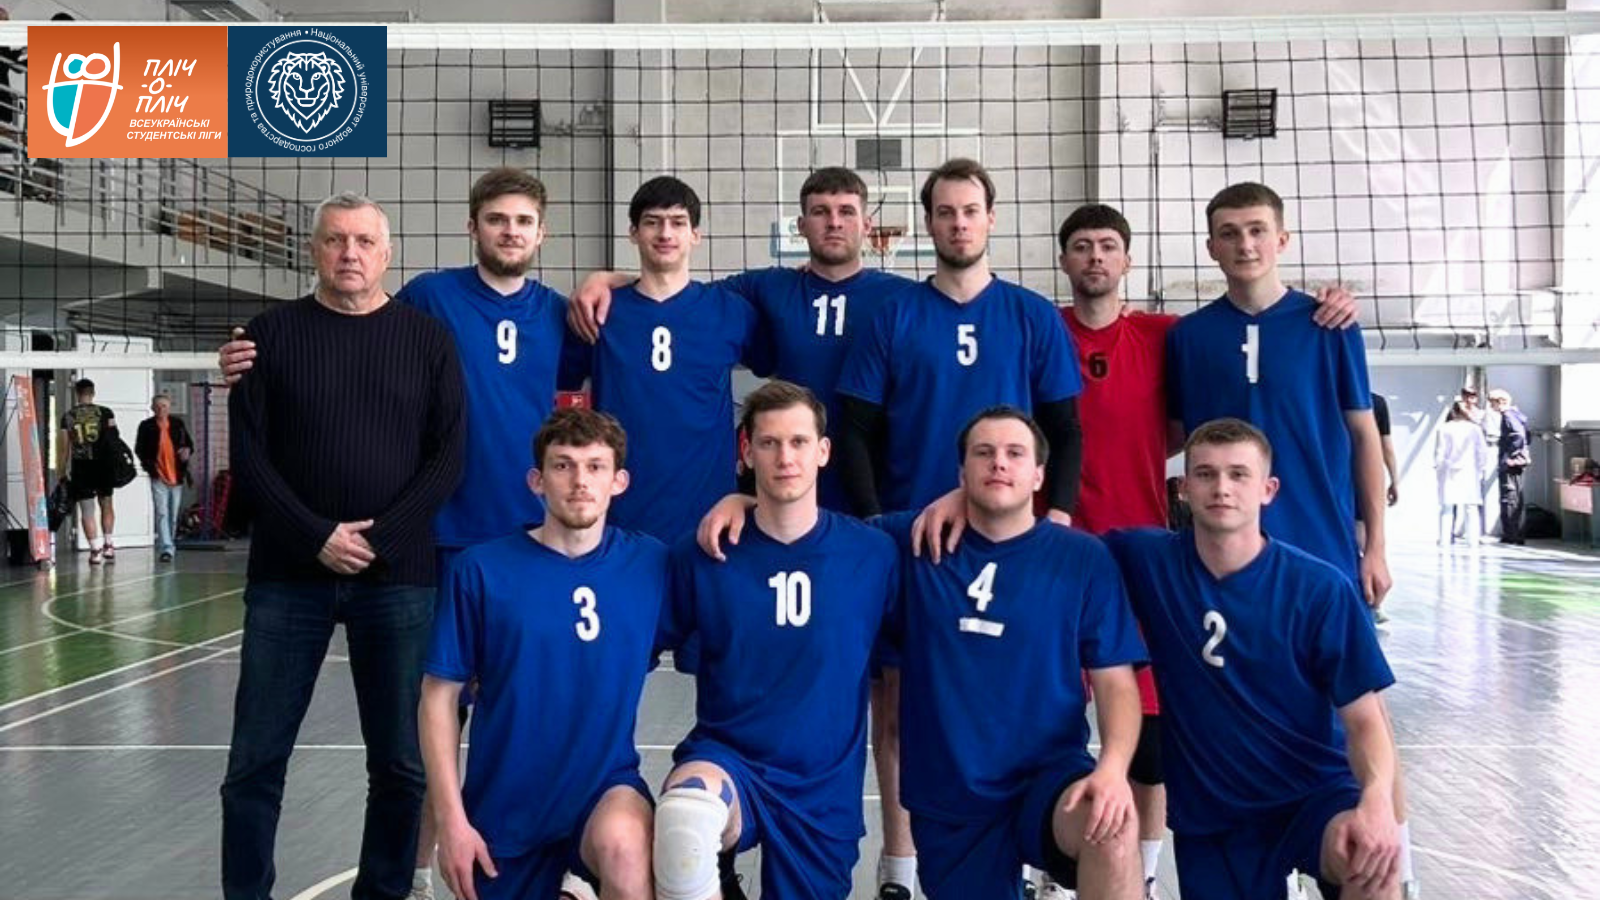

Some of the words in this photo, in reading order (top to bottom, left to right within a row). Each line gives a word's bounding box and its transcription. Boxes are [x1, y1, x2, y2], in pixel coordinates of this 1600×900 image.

[813, 295, 846, 336] 11
[497, 320, 518, 364] 9
[651, 326, 672, 371] 8
[957, 324, 978, 366] 5
[1242, 325, 1259, 384] 1
[1088, 352, 1108, 378] 6
[74, 421, 99, 444] 15
[768, 571, 812, 627] 10
[967, 561, 997, 612] 4
[573, 587, 600, 642] 3
[1203, 610, 1227, 668] 2
